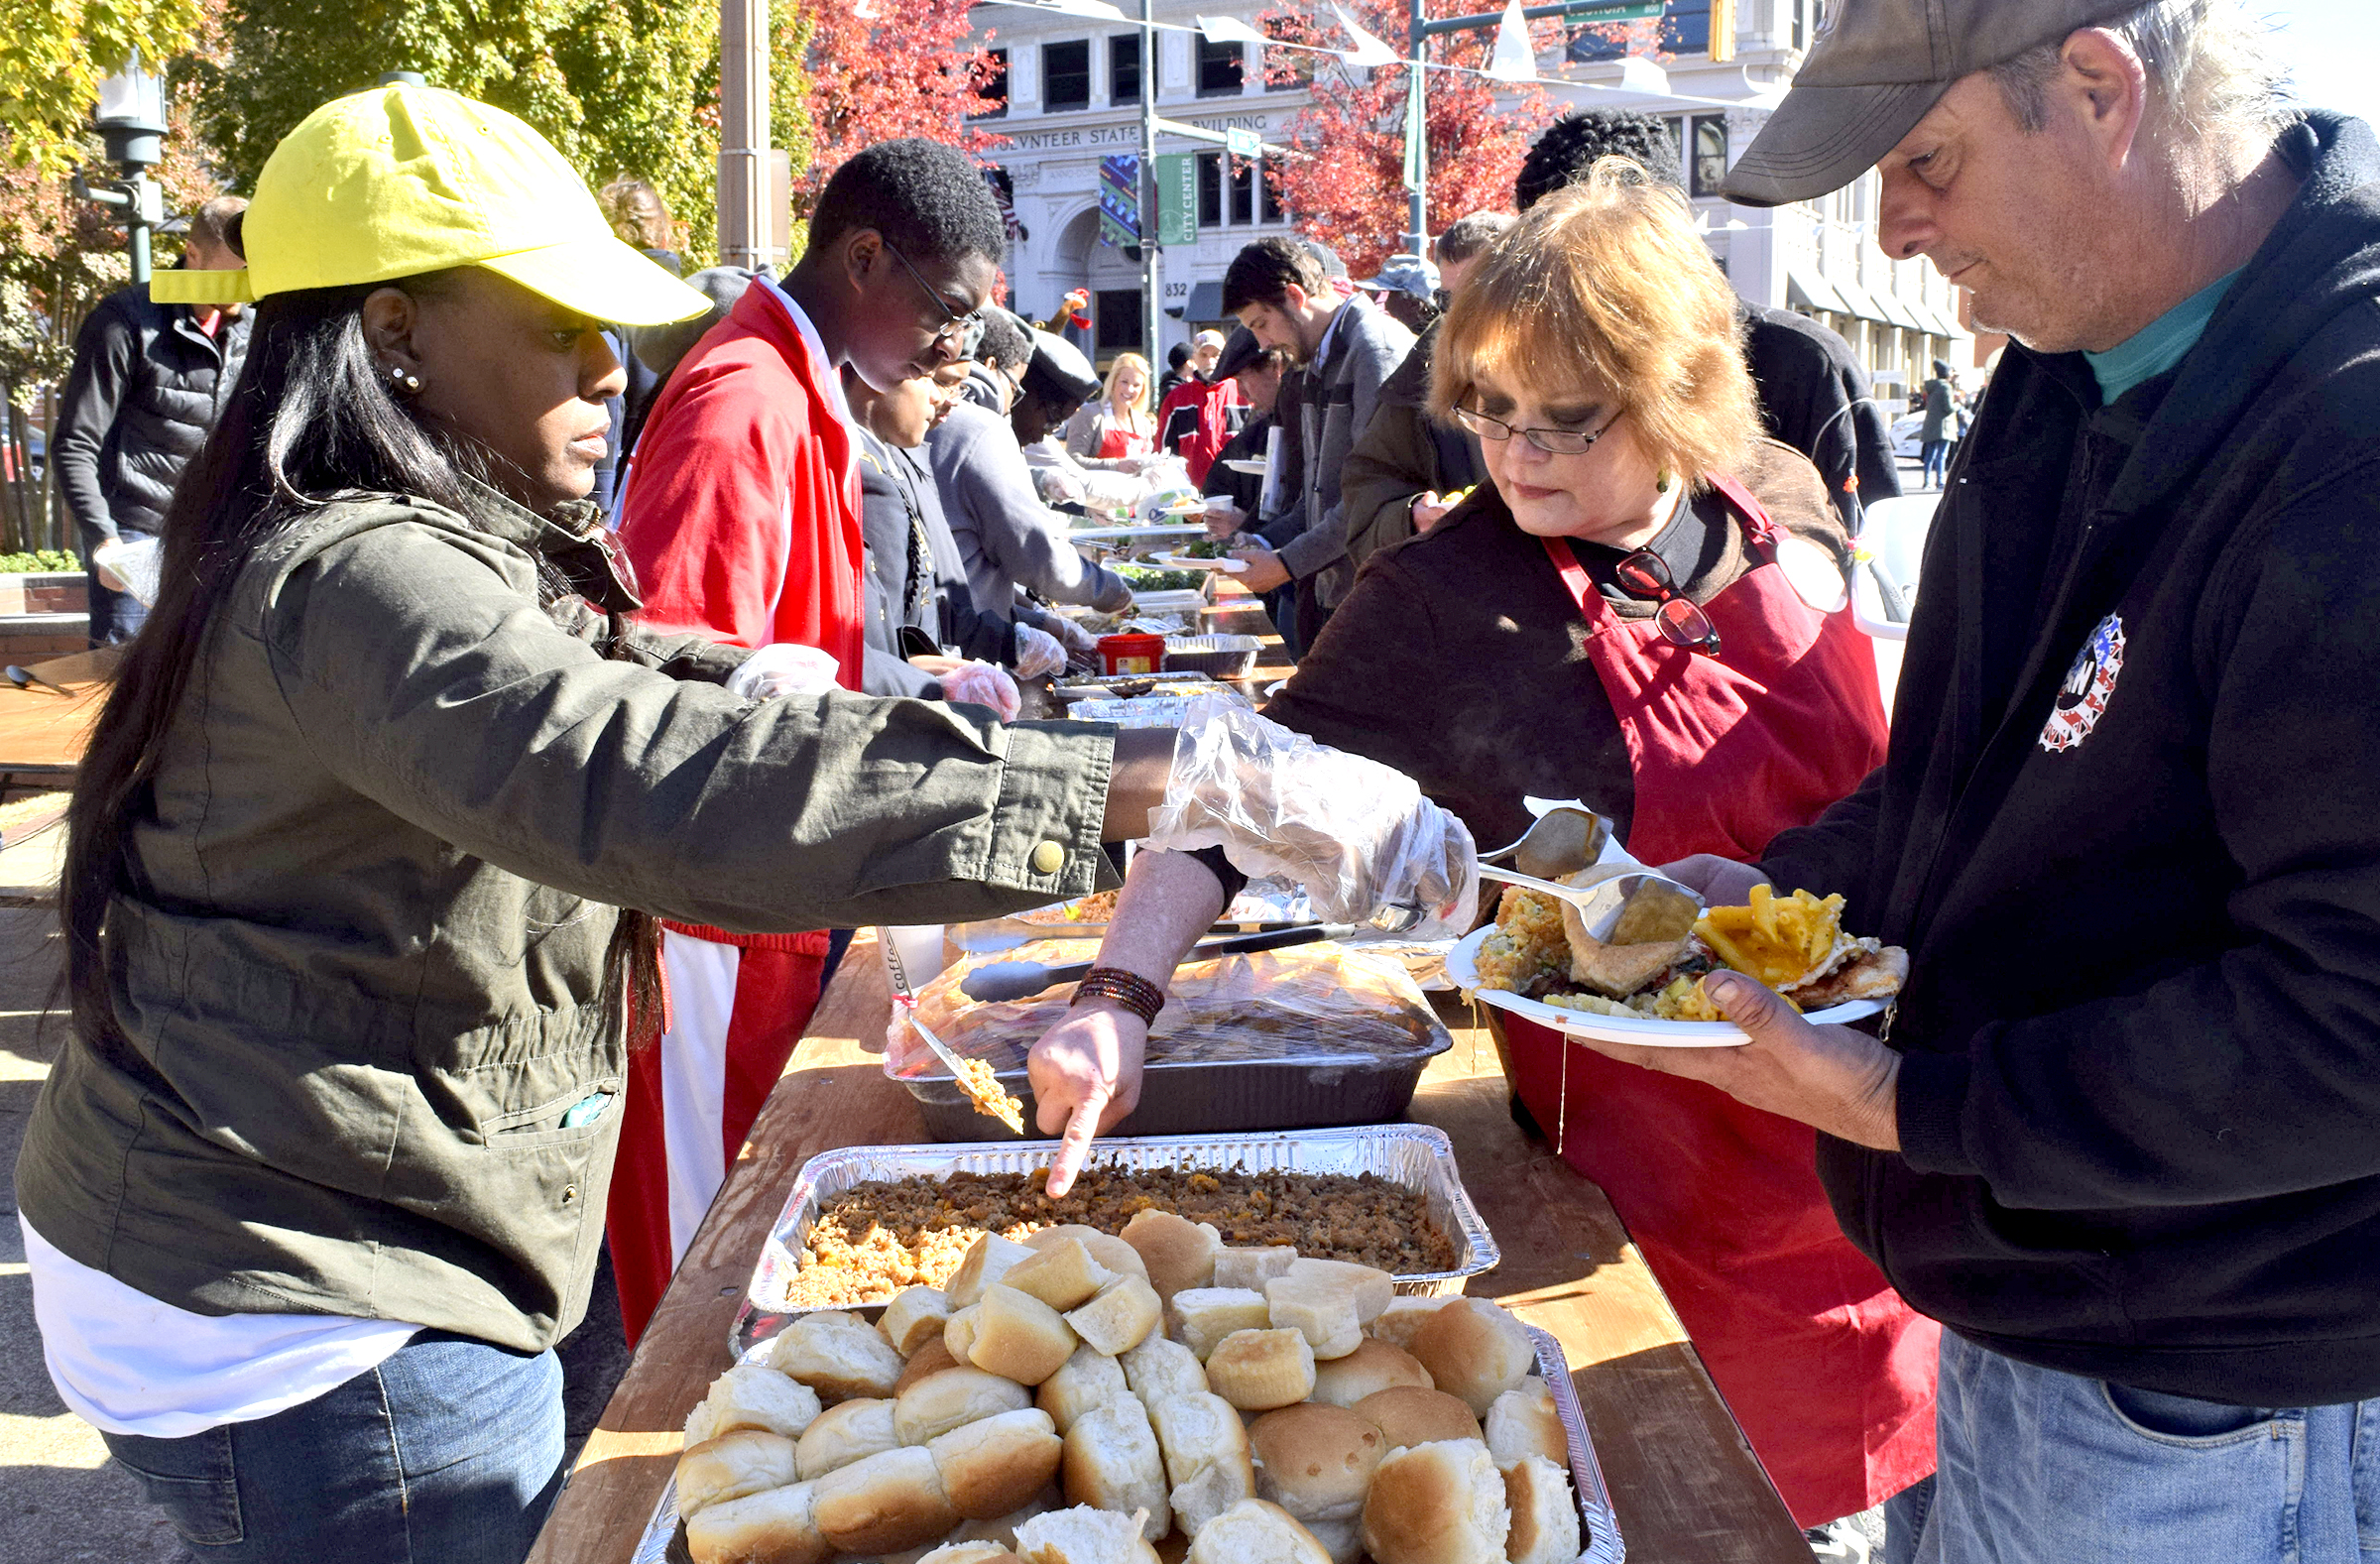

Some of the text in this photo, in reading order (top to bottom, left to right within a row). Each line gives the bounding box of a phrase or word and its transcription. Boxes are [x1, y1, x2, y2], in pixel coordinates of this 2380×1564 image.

[1090, 125, 1139, 144] STATE
[1181, 157, 1194, 241] CITY CENTER
[1165, 283, 1187, 297] 832
